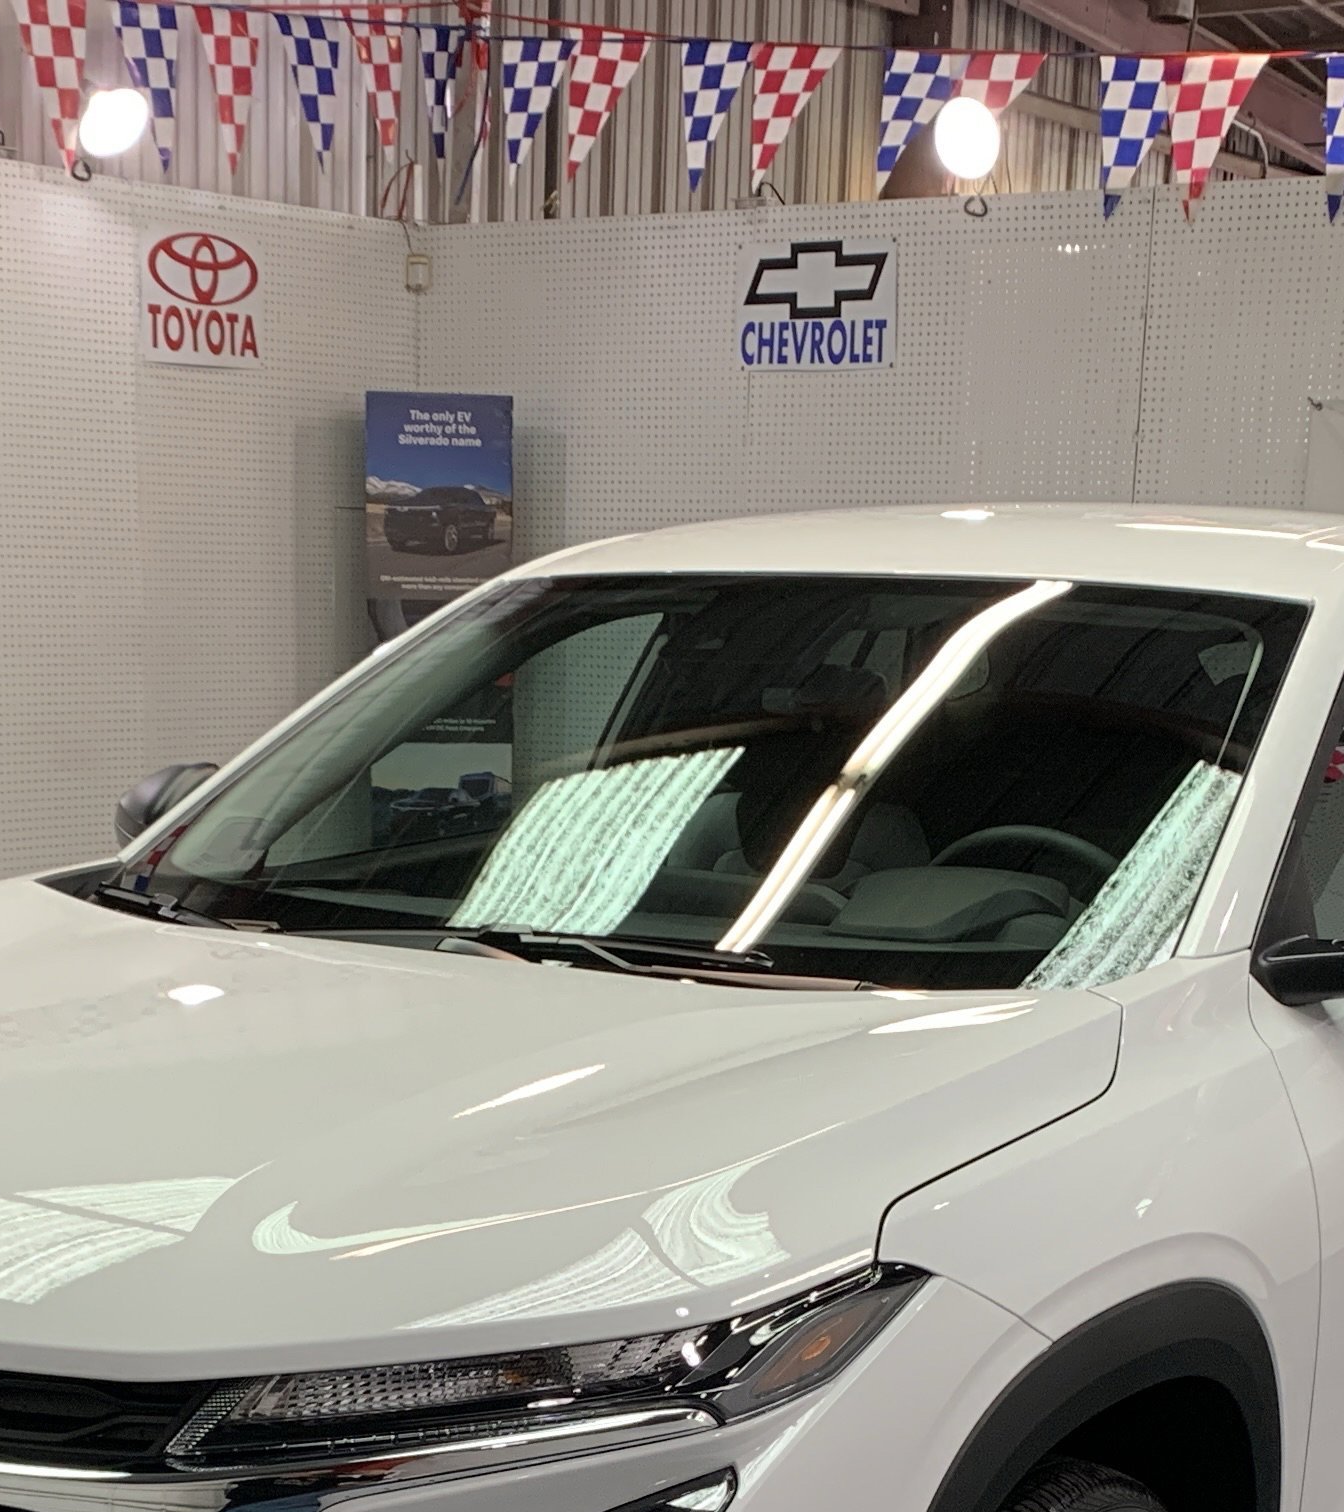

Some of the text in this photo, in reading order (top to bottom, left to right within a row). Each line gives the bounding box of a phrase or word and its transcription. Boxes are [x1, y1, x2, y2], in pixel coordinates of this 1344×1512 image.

[148, 303, 259, 358] TOYOTA
[741, 319, 887, 365] CHEVROLET
[409, 409, 472, 423] The only EV
[404, 423, 476, 435] worthy of the
[398, 434, 481, 447] Silverado name
